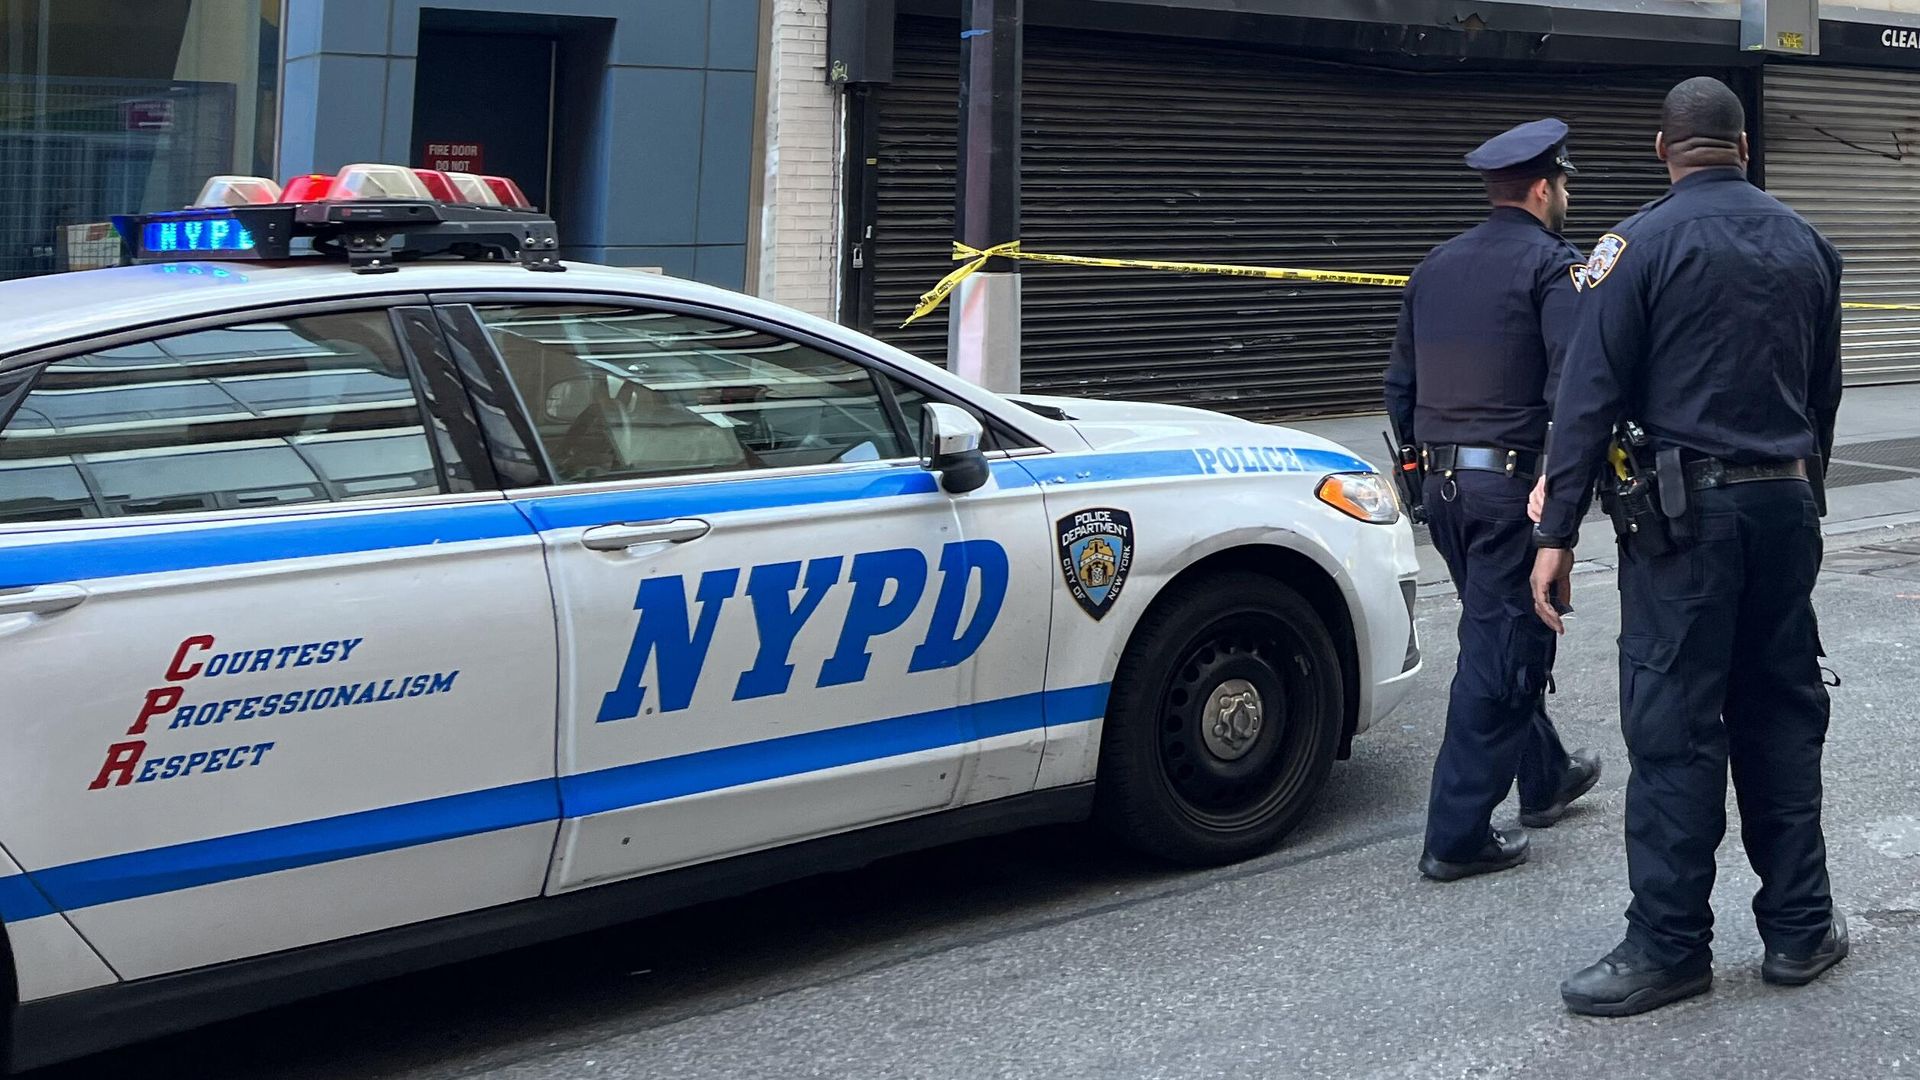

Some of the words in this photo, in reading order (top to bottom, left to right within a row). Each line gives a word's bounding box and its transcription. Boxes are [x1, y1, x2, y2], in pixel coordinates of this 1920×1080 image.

[1881, 29, 1920, 49] CLEA
[429, 144, 450, 156] FIRE
[451, 145, 478, 156] DOOR
[435, 160, 449, 171] DO
[451, 160, 470, 171] NOT
[1195, 446, 1301, 474] POLICE
[1074, 511, 1112, 526] POLICE
[1062, 522, 1128, 546] DEPARTMENT
[1063, 557, 1077, 584] CITY
[1072, 586, 1086, 600] OF
[1107, 575, 1123, 601] NEW
[1119, 545, 1131, 573] YORK
[595, 539, 1010, 723] NYPD
